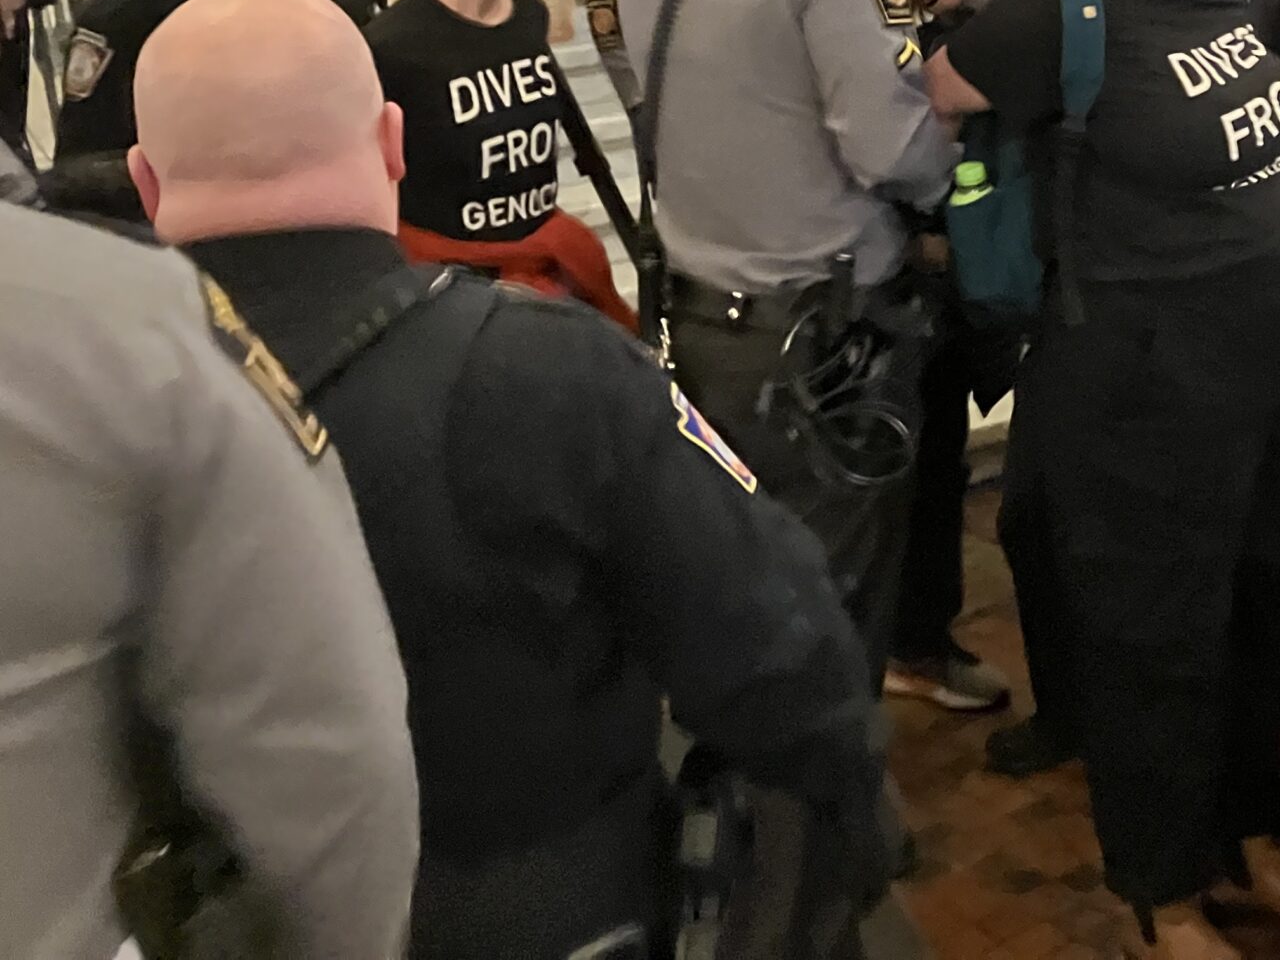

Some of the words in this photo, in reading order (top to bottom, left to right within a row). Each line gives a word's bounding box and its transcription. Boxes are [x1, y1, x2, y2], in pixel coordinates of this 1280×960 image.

[449, 54, 557, 124] DIVES
[1167, 23, 1267, 98] DIVES
[481, 119, 559, 179] FRO
